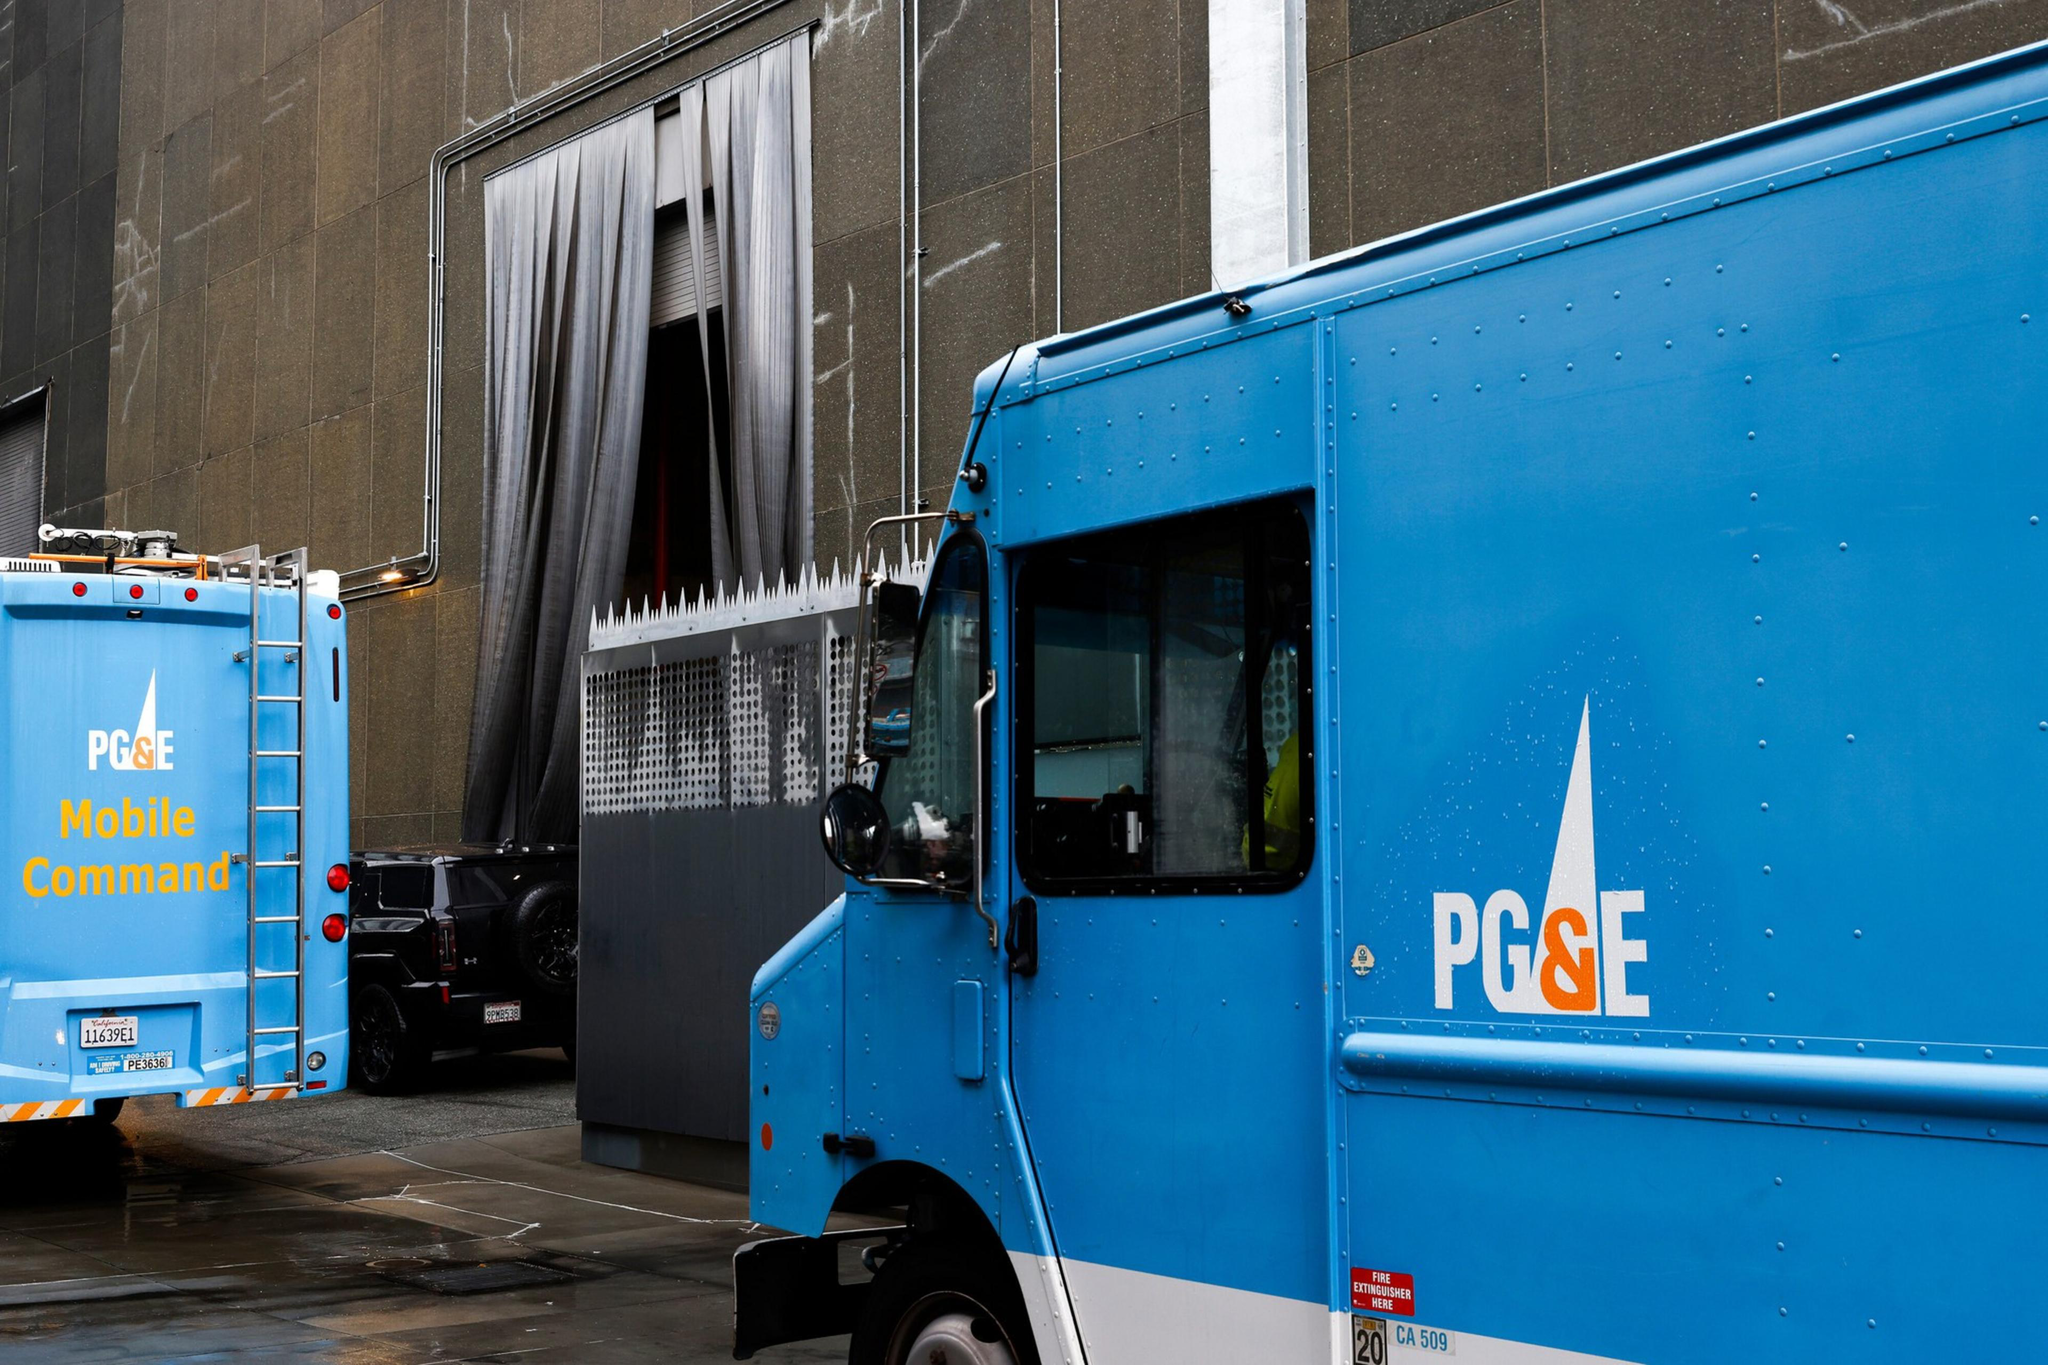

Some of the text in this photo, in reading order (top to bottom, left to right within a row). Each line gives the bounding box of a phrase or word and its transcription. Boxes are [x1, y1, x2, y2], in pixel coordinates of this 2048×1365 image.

[88, 729, 174, 771] PG&E
[60, 796, 195, 839] Mobile
[22, 850, 230, 898] Command
[1432, 889, 1650, 1017] PG&E
[92, 1019, 126, 1028] California
[85, 1027, 135, 1044] 11639E1
[128, 1058, 165, 1070] PE3636
[1372, 1271, 1391, 1284] FIRE
[1353, 1282, 1411, 1300] EXTINGUISHER
[1371, 1297, 1393, 1310] HERE
[1357, 1329, 1384, 1365] 20
[1396, 1325, 1416, 1346] CA
[1420, 1329, 1448, 1351] 509
